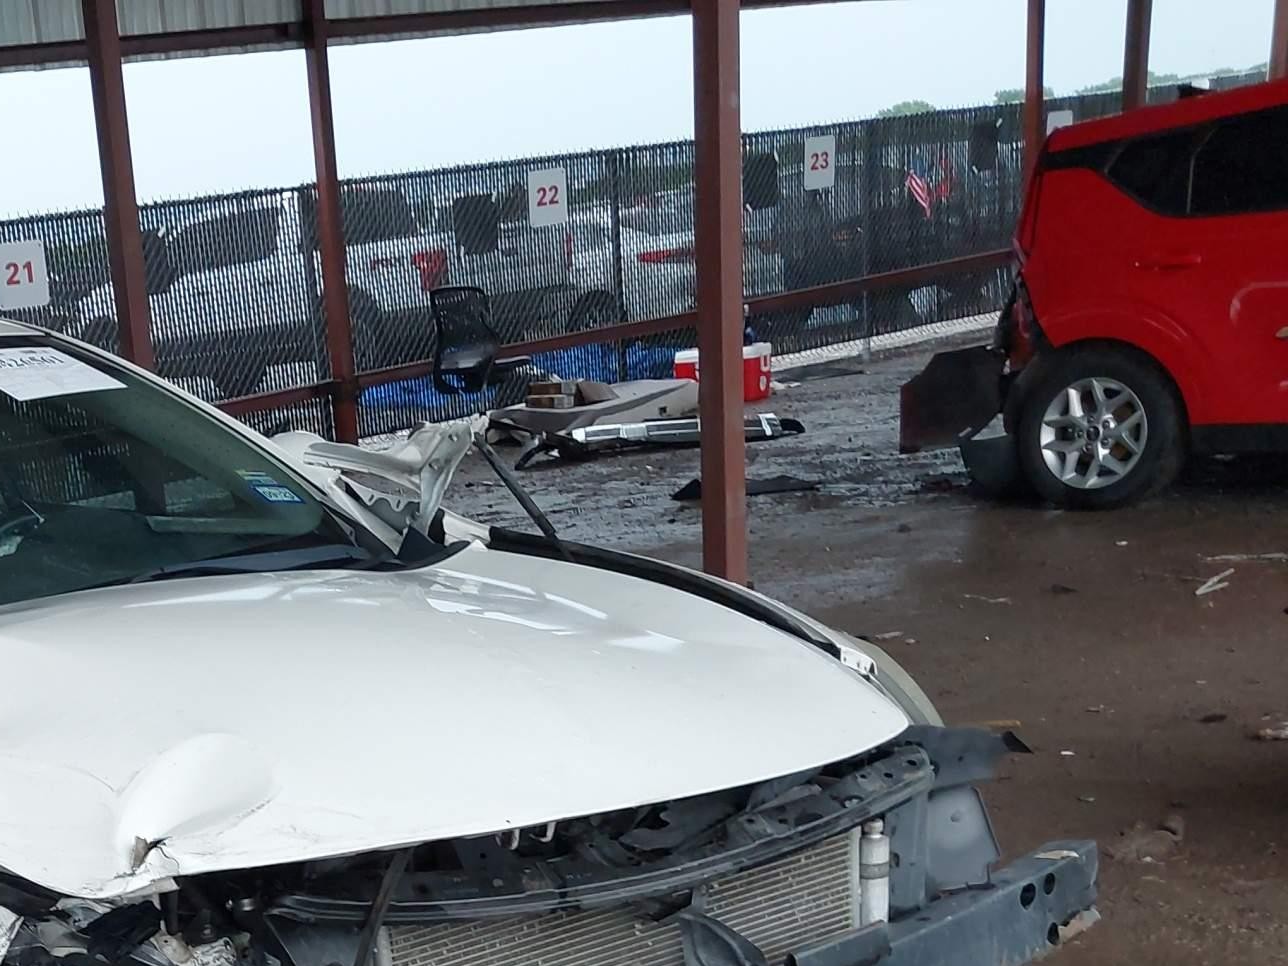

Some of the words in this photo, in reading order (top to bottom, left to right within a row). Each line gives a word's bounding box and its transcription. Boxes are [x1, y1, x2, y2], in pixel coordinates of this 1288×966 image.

[810, 151, 829, 171] 23
[536, 184, 560, 207] 22
[5, 260, 34, 285] 21
